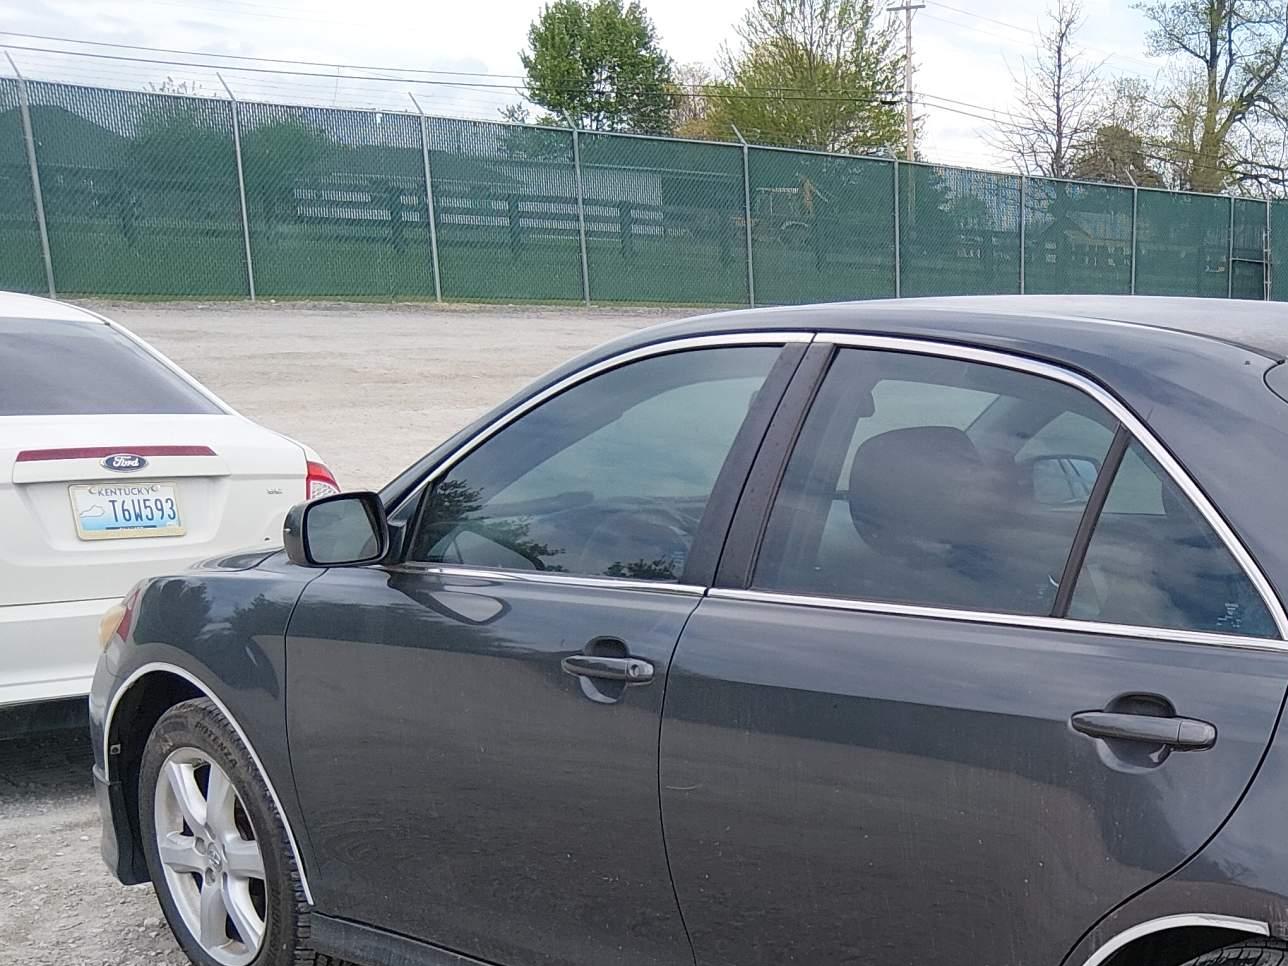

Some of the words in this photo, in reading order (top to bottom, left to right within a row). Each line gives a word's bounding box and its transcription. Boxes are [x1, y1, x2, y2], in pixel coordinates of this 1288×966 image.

[112, 456, 140, 467] Ford
[97, 486, 151, 497] KENTUCKY
[108, 498, 176, 522] T6W593
